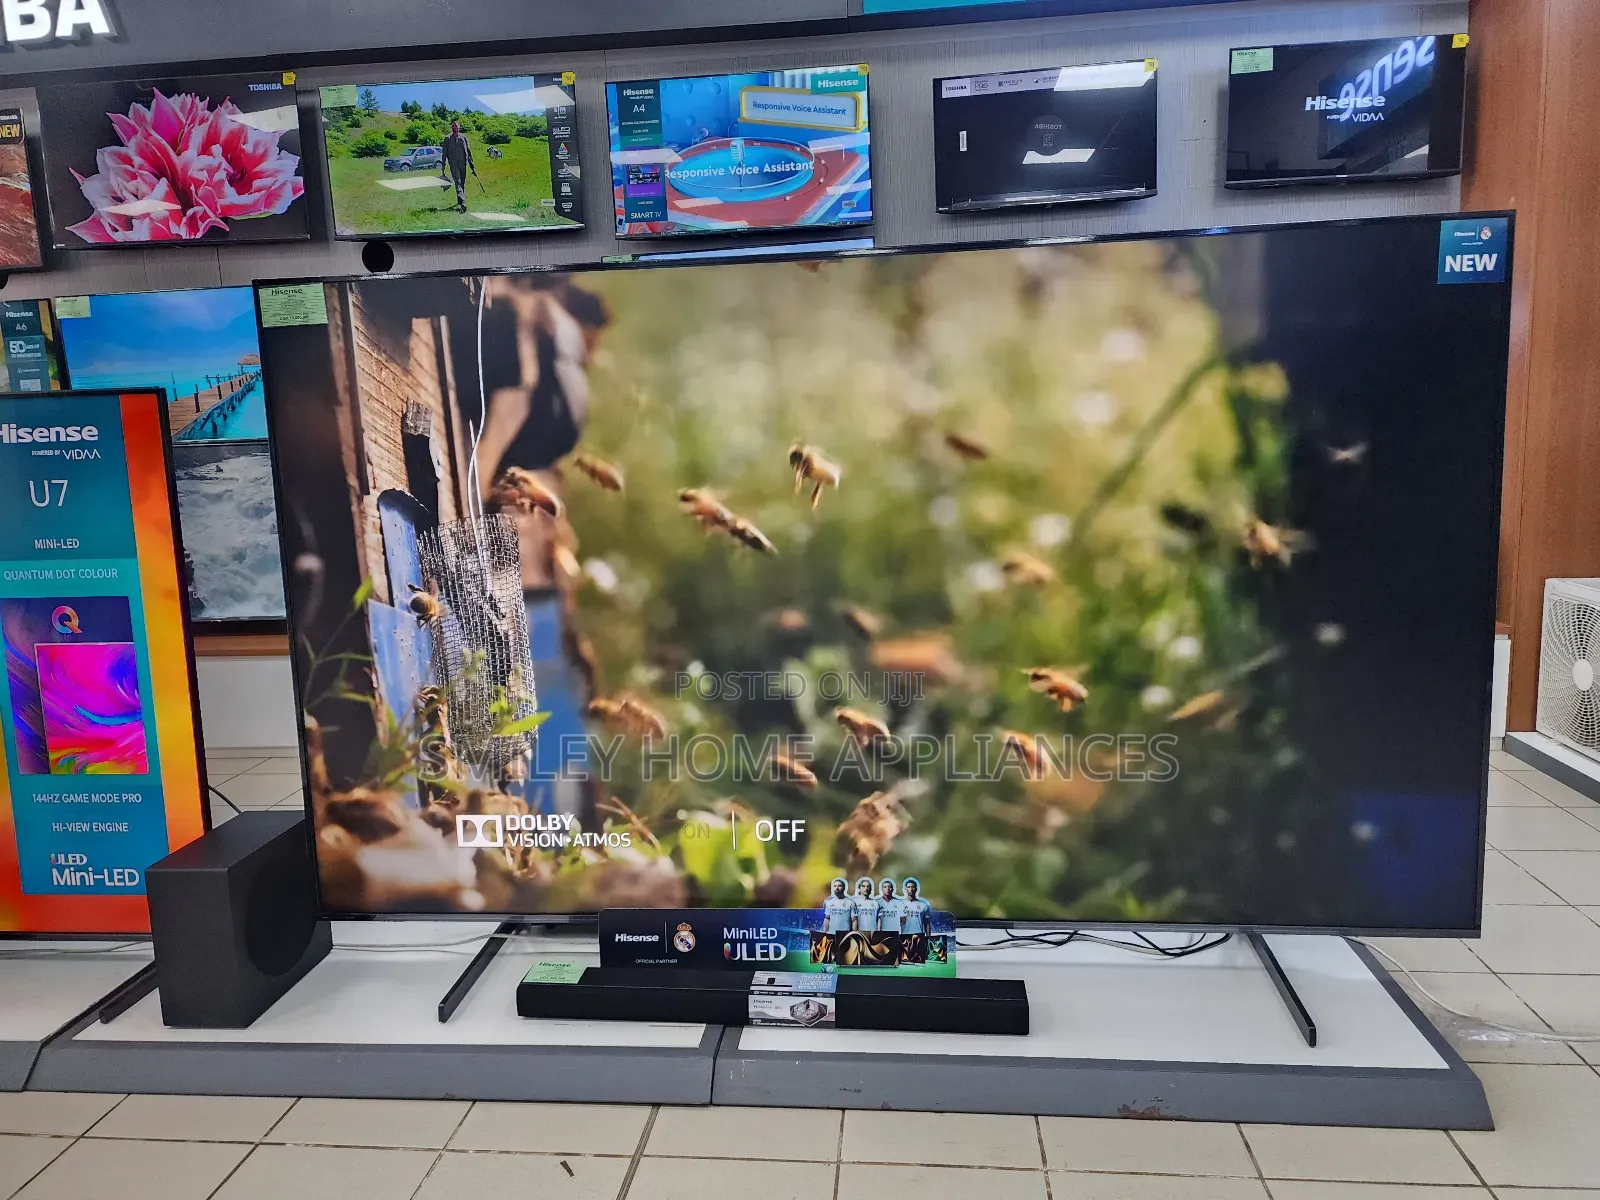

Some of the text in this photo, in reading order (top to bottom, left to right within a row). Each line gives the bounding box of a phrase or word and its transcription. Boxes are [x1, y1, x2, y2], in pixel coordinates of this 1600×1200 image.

[248, 83, 282, 91] TOSHIBA
[817, 79, 859, 88] Hisense
[623, 88, 654, 96] Hisense
[632, 103, 646, 113] A4
[752, 101, 847, 115] Responsive Voice Assistant
[1305, 95, 1385, 111] Hisense
[728, 164, 760, 176] Voice
[762, 159, 815, 173] Assistant
[630, 211, 654, 219] SMART
[1444, 252, 1498, 273] NEW
[15, 322, 28, 331] A6
[62, 448, 102, 460] VIDAA
[28, 479, 69, 507] U7
[34, 538, 80, 550] MINI-LED
[3, 568, 119, 581] QUANTUM DOT COLOUR
[32, 793, 142, 804] 144HZ GAME MODE PRO
[51, 821, 129, 833] HI-VIEW ENGINE
[505, 814, 574, 832] DOLBY
[682, 823, 710, 840] ON
[754, 819, 806, 842] OFF
[49, 853, 88, 866] ULED
[51, 868, 140, 886] Mini-LED
[614, 933, 660, 943] Hisense
[723, 927, 778, 940] MiniLED
[723, 942, 788, 962] ULED
